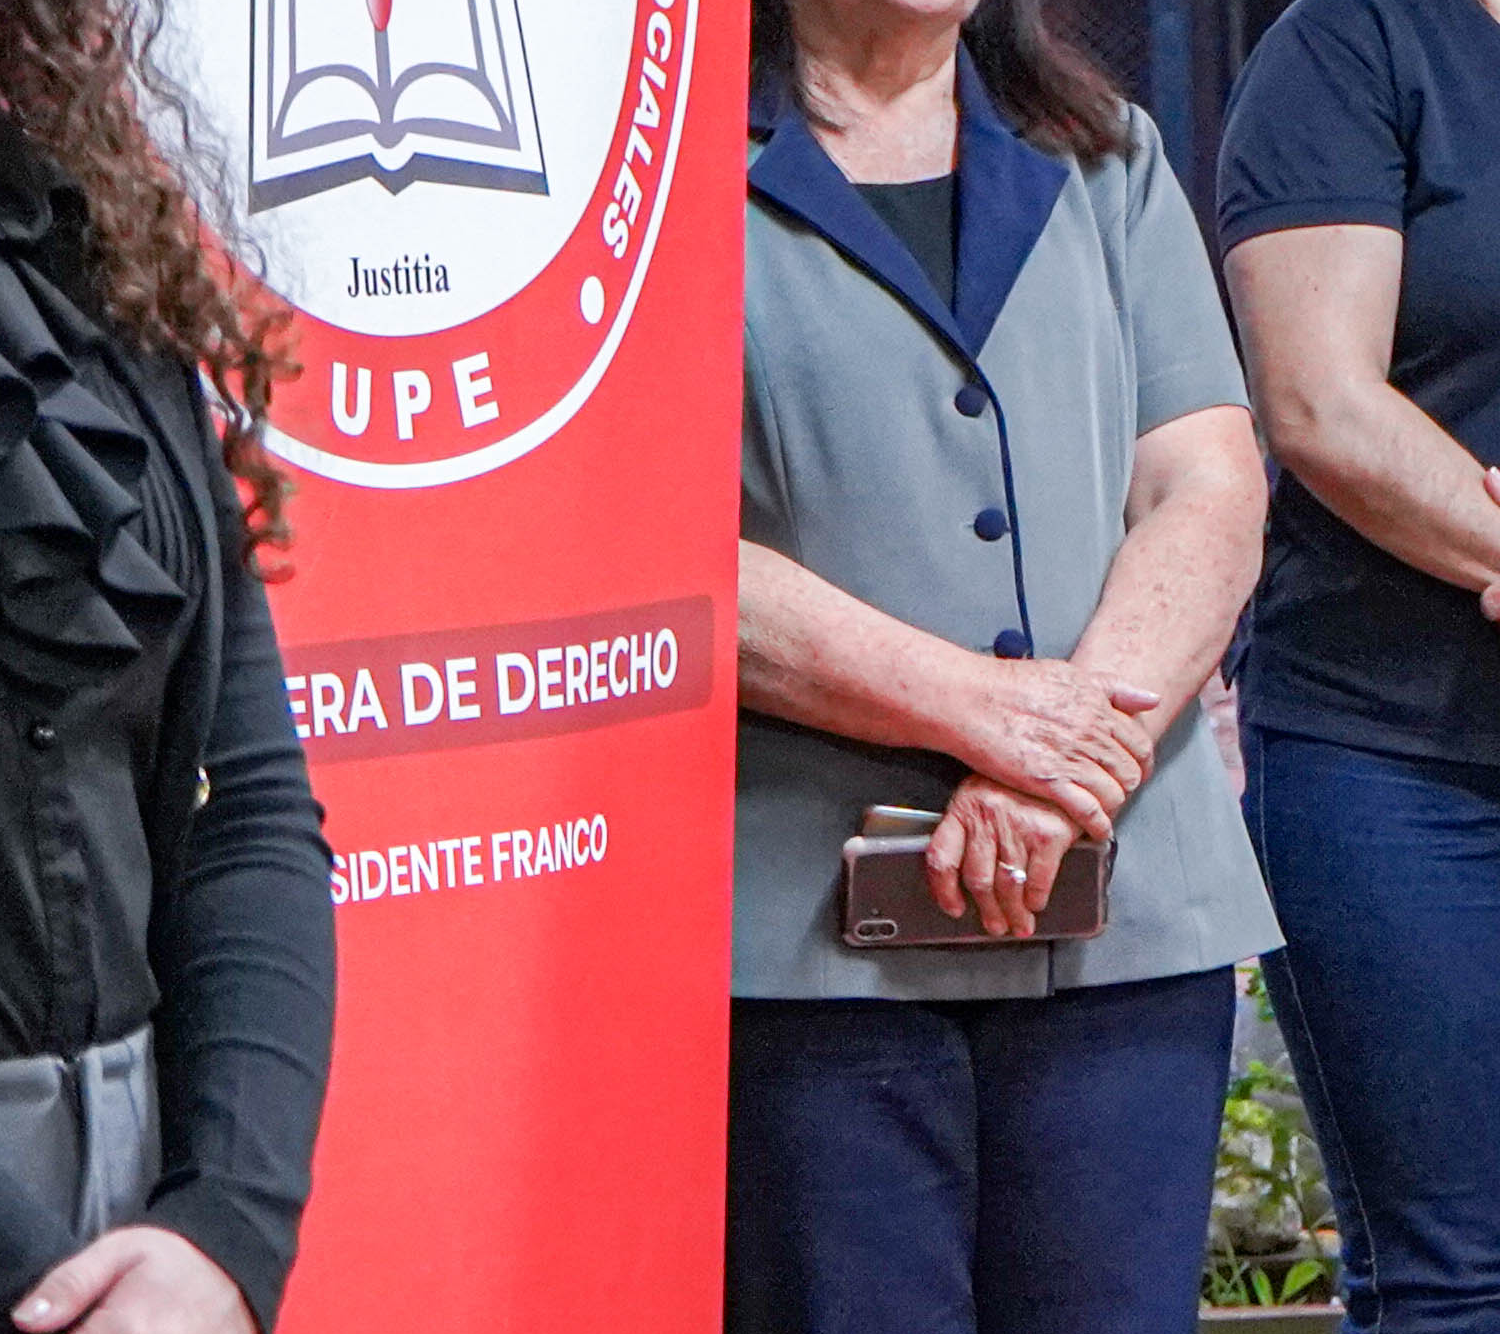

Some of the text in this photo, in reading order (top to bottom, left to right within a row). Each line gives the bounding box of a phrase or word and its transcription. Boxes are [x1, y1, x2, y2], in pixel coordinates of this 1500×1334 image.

[347, 253, 451, 298] Justitia
[331, 350, 501, 442] UPE
[283, 628, 679, 739] ERA DE DERECHO
[330, 813, 609, 905] SIDENTE FRANCO
